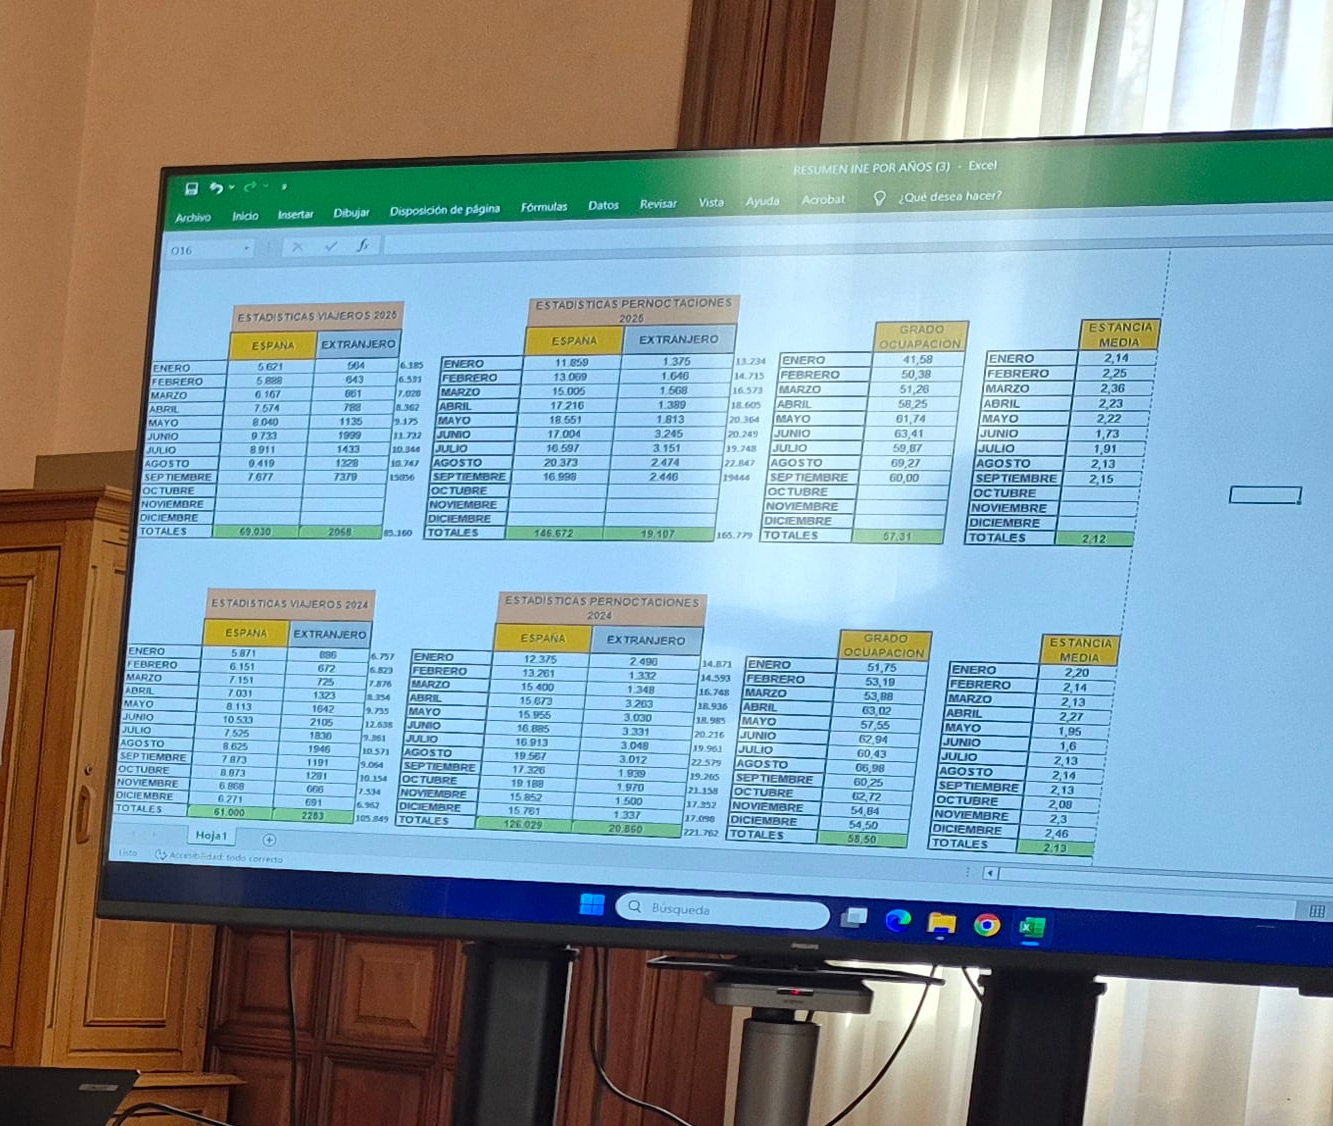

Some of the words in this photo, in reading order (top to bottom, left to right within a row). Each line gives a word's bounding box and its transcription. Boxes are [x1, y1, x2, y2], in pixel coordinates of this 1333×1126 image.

[794, 164, 848, 176] RESUMEN
[851, 164, 869, 174] INE
[873, 163, 895, 173] POR
[899, 161, 932, 172] AÑOS
[969, 161, 997, 171] Excel
[699, 198, 724, 207] Vista
[746, 196, 779, 208] Ayuda
[802, 195, 845, 205] Acrobat
[899, 193, 927, 204] ¿Qué
[931, 192, 962, 201] desea
[966, 191, 1002, 200] hacer?
[521, 202, 568, 212] Fórmulas
[589, 201, 619, 210] Datos
[640, 199, 677, 209] Revisar
[233, 211, 259, 221] Inicio
[278, 210, 314, 219] Insertar
[334, 208, 370, 219] Dibujar
[390, 204, 447, 218] Disposición
[451, 205, 463, 214] de
[465, 204, 500, 216] página
[175, 212, 211, 223] Archivo
[622, 297, 732, 308] PERNOCTACIONES
[318, 311, 371, 320] VIAJEROS
[900, 324, 944, 335] GRADO
[1089, 322, 1152, 332] ESTANCIA
[640, 334, 718, 344] EXTRANJERO
[1099, 337, 1139, 347] MEDIA
[322, 339, 396, 350] EXTRANJERO
[989, 353, 1034, 363] ENERO
[154, 364, 190, 372] ENERO
[988, 368, 1049, 378] FEBRERO
[152, 377, 203, 386] FEBRERO
[986, 384, 1029, 393] MARZO
[151, 390, 187, 399] MARZO
[149, 404, 179, 413] ABRIL
[984, 399, 1020, 408] ABRIL
[149, 419, 178, 427] MAYO
[982, 413, 1018, 423] MAYO
[147, 432, 179, 440] JUNIO
[980, 428, 1018, 438] JUNIO
[146, 446, 176, 454] JULIO
[979, 444, 1014, 453] JULIO
[145, 459, 189, 468] AGOSTO
[977, 458, 1030, 468] AGOSTO
[145, 473, 212, 481] SEPTIEMBRE
[976, 473, 1057, 483] SEPTIEMBRE
[143, 486, 195, 495] OCTUBRE
[973, 488, 1036, 498] OCTUBRE
[141, 500, 204, 508] NOVIEMBRE
[972, 503, 1046, 512] NOVIEMBRE
[140, 513, 198, 522] DICIEMBRE
[970, 518, 1040, 528] DICIEMBRE
[140, 527, 187, 536] TOTALES
[970, 532, 1026, 542] TOTALES
[291, 599, 342, 609] VIAJEROS
[345, 601, 368, 610] 2024
[590, 597, 699, 608] PERNOCTACIONES
[588, 611, 612, 621] 2024
[294, 630, 366, 640] EXTRANJERO
[864, 633, 908, 644] GRADO
[607, 635, 685, 646] EXTRANJERO
[1050, 638, 1112, 649] ESTANCIA
[414, 652, 454, 662] ENERO
[1060, 652, 1099, 663] MEDIA
[412, 666, 467, 677] FEBRERO
[952, 664, 996, 676] ENERO
[411, 680, 450, 690] MARZO
[950, 679, 1011, 691] FEBRERO
[410, 693, 442, 703] ABRIL
[949, 693, 992, 705] MARZO
[947, 708, 982, 719] ABRIL
[399, 816, 449, 825] TOTALES
[196, 831, 227, 841] Hoja1
[933, 838, 988, 850] TOTALES
[653, 903, 709, 916] Búsqueda
